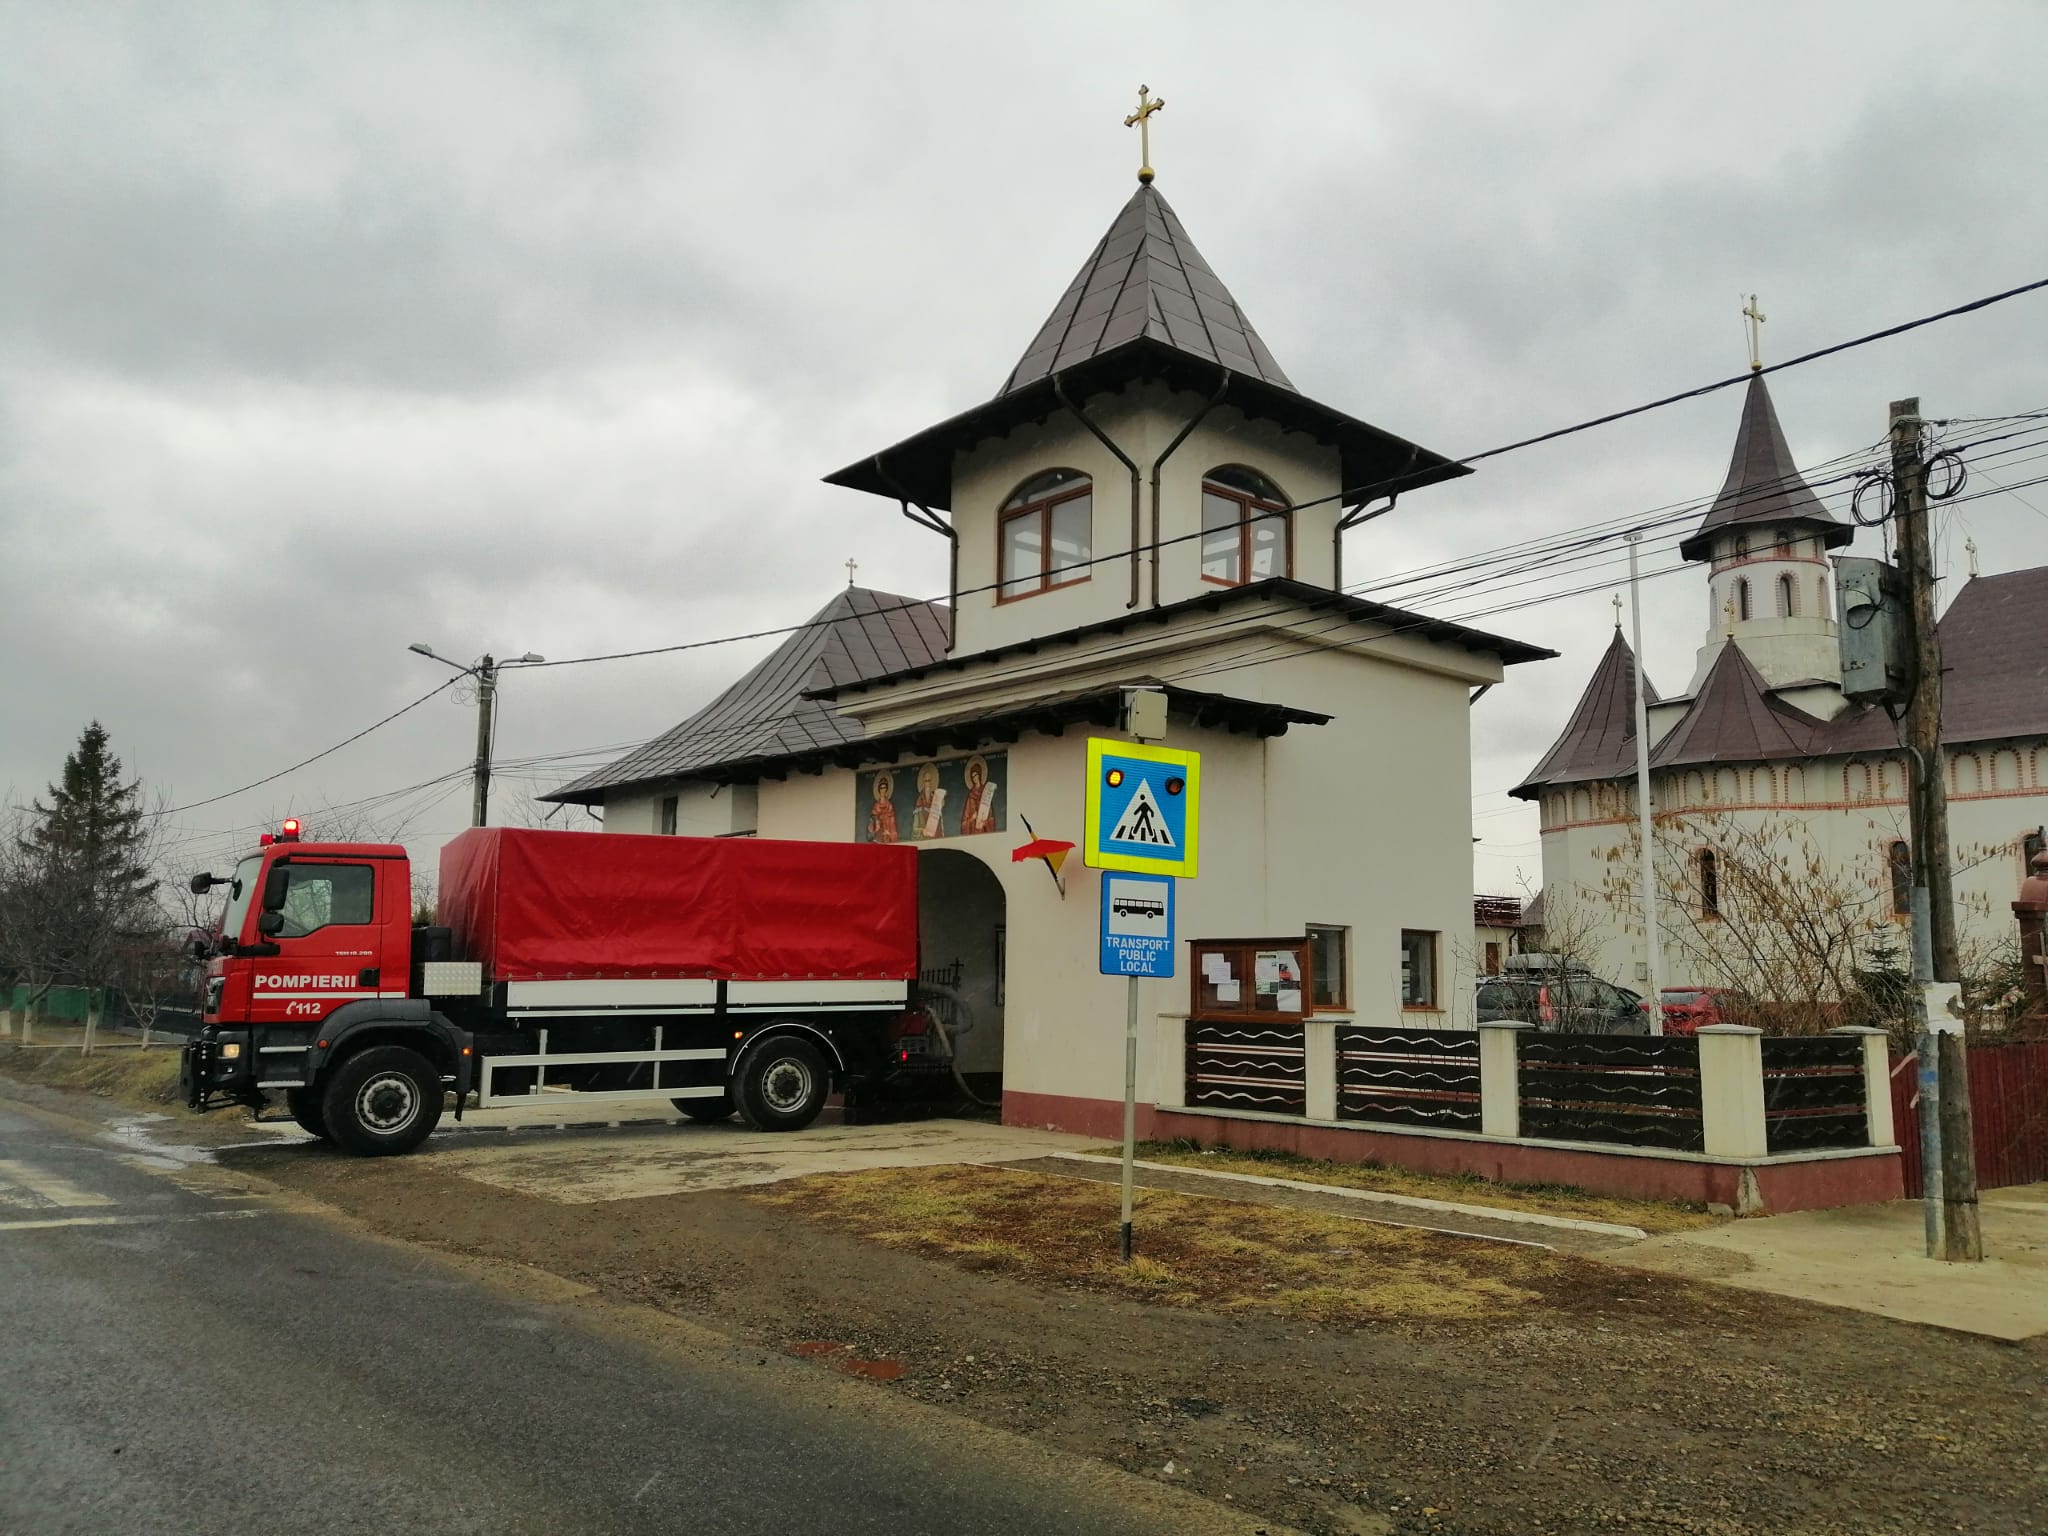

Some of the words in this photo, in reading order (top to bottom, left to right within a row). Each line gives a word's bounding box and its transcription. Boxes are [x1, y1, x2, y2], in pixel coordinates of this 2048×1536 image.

[1106, 936, 1170, 951] TRANSPORT
[1119, 949, 1156, 962] PUBLIC
[1120, 960, 1155, 973] LOCAL
[254, 974, 356, 988] POMPIERII
[296, 1002, 321, 1014] 112
